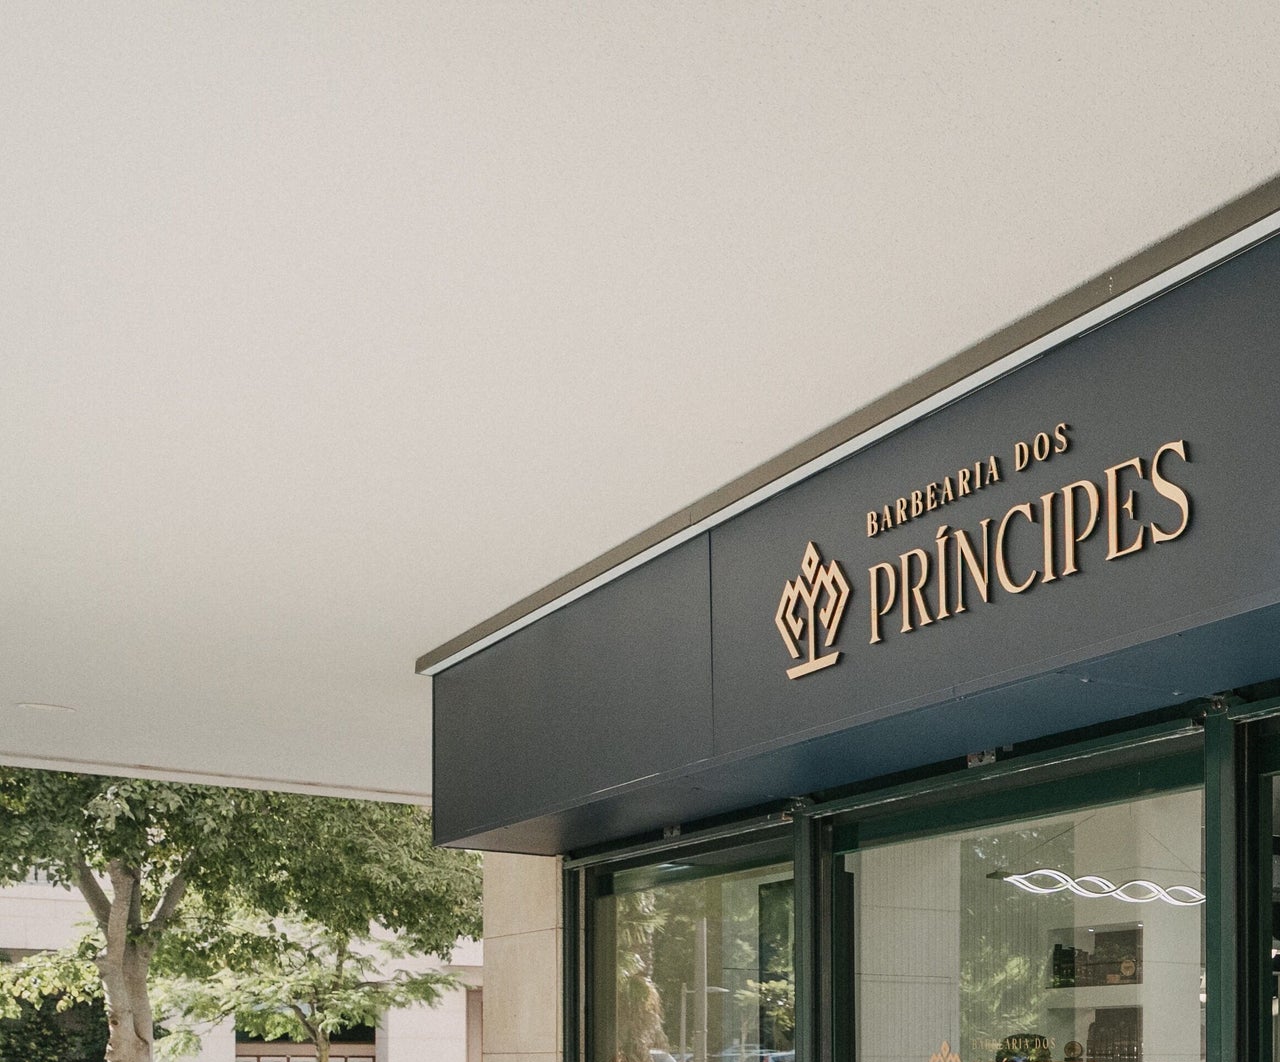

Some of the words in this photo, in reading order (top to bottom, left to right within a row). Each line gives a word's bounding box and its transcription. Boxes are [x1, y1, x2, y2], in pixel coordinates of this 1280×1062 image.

[866, 455, 1001, 538] BARBEARIA
[1014, 422, 1071, 472] DOS
[868, 439, 1192, 645] PRÍNCIPES
[1034, 1037, 1057, 1050] DOS
